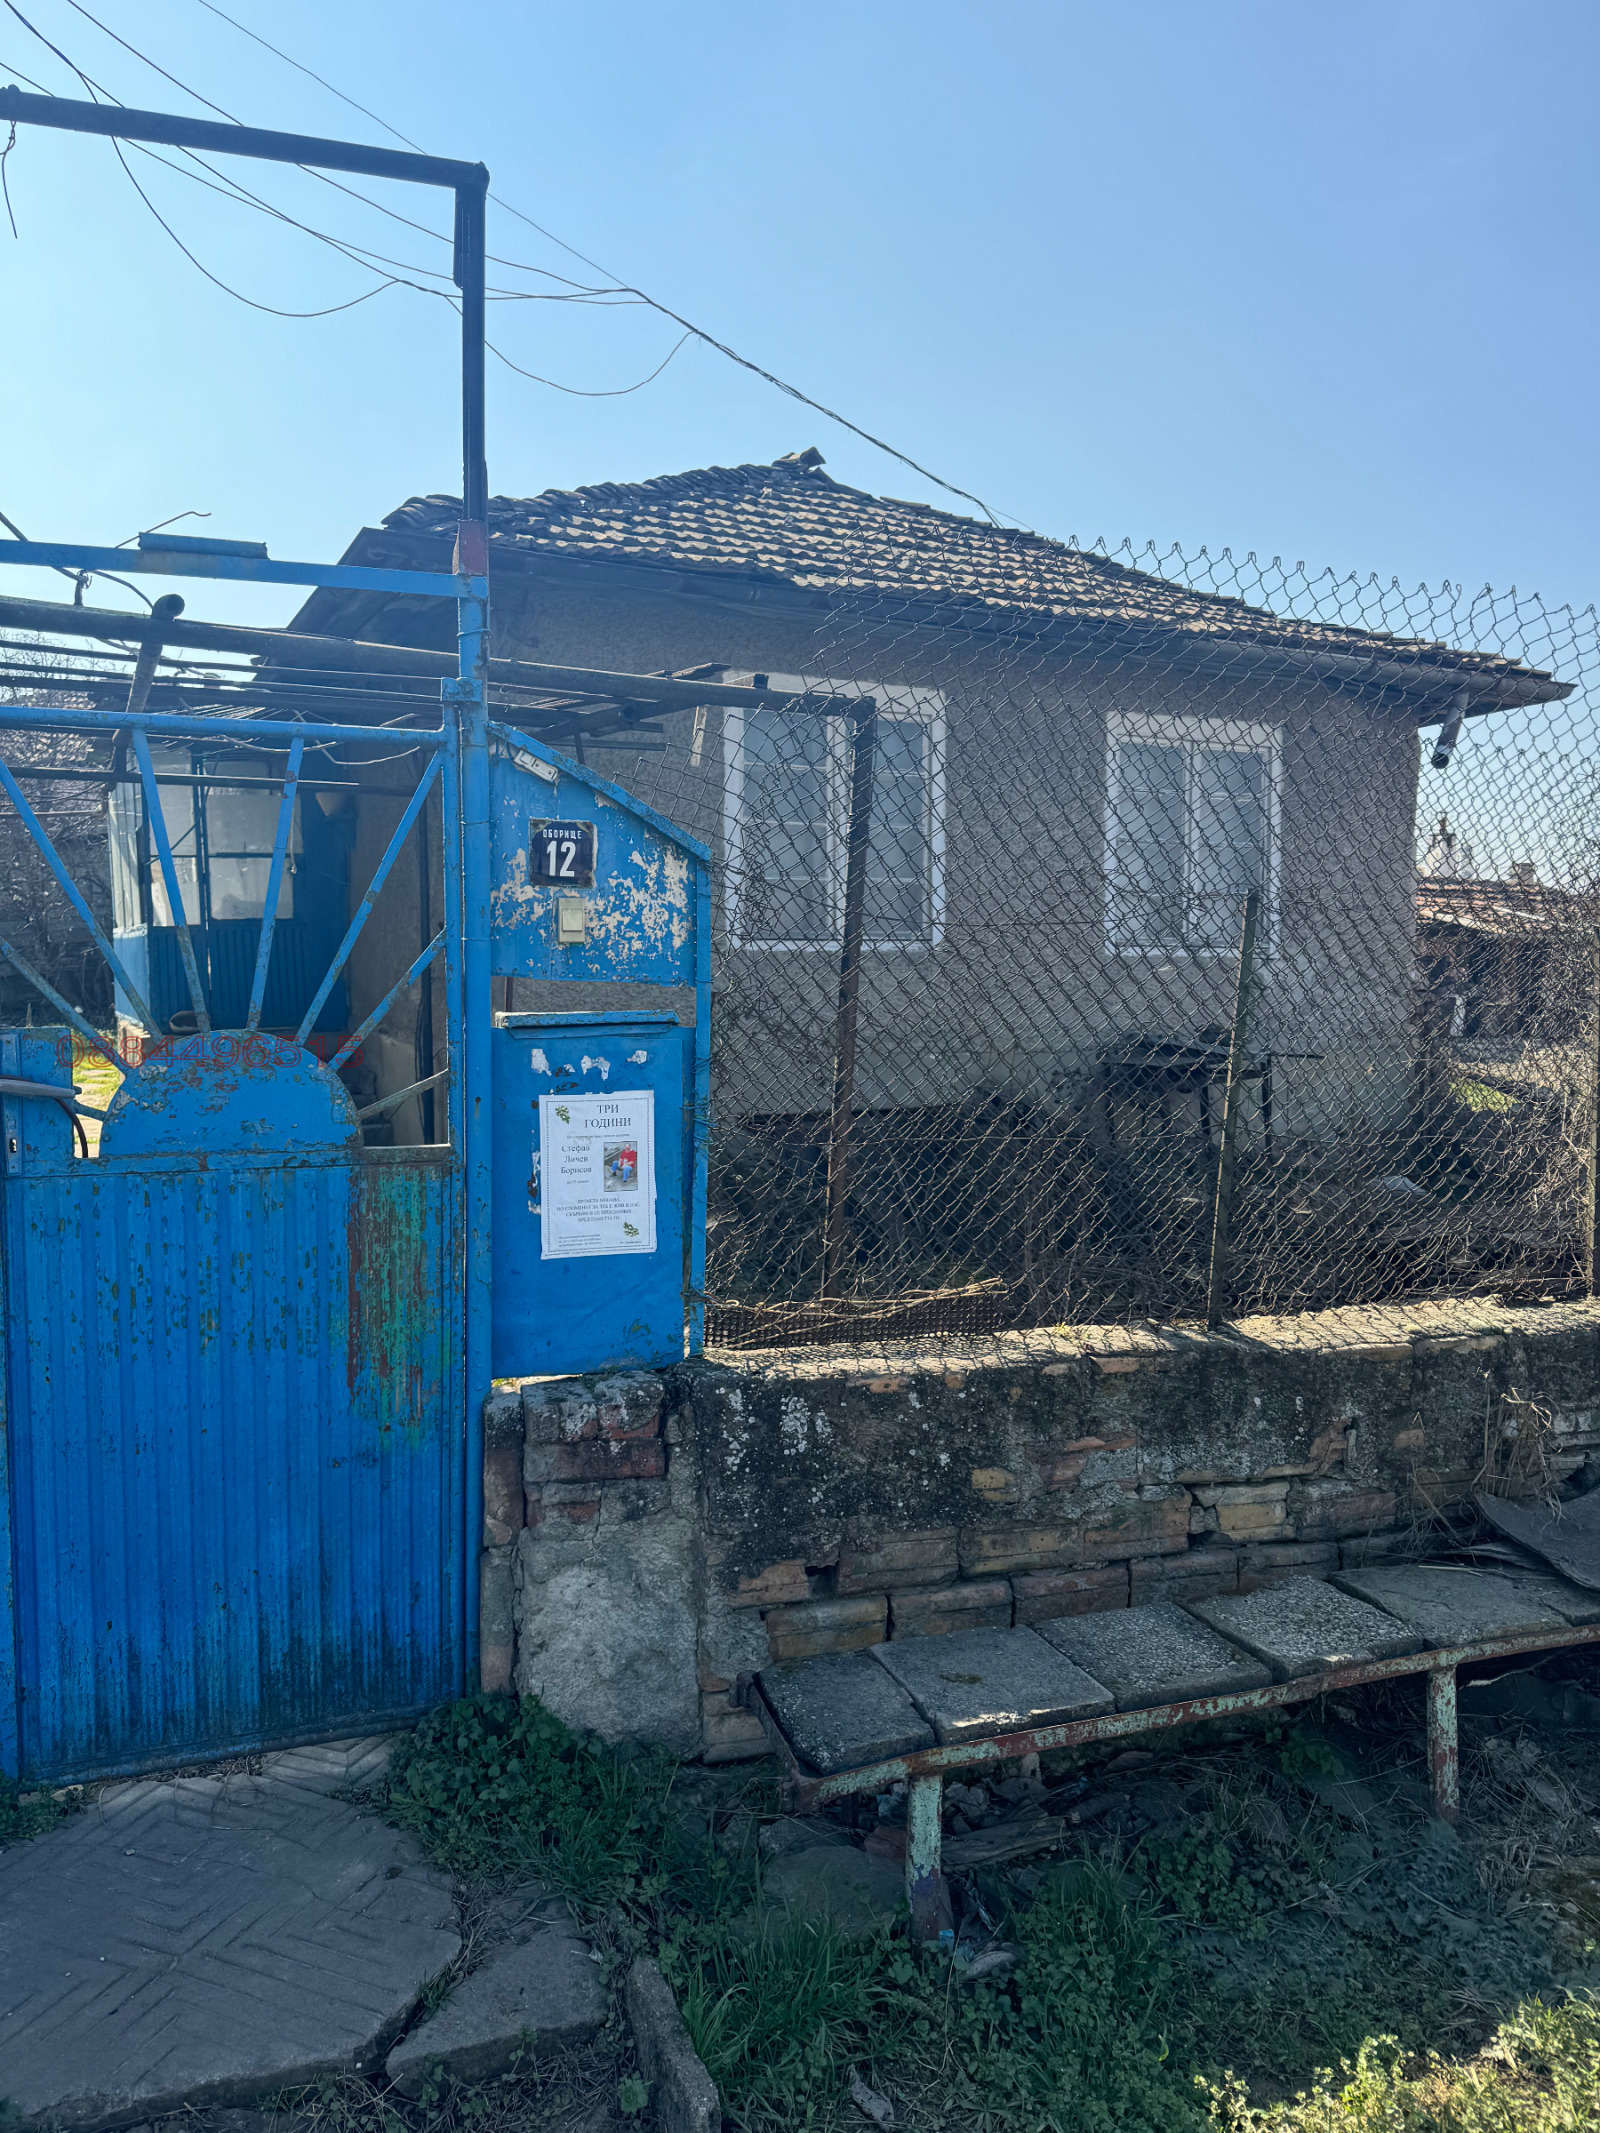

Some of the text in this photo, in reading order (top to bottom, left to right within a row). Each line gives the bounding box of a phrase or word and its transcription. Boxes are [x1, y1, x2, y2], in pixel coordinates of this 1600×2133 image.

[542, 829, 582, 839] ОБОРИЩЕ
[546, 840, 576, 877] 12
[597, 1104, 619, 1114] ТРИ
[584, 1117, 631, 1129] ГОДИНИ
[561, 1145, 590, 1154] Стефан
[560, 1166, 592, 1176] Борисов
